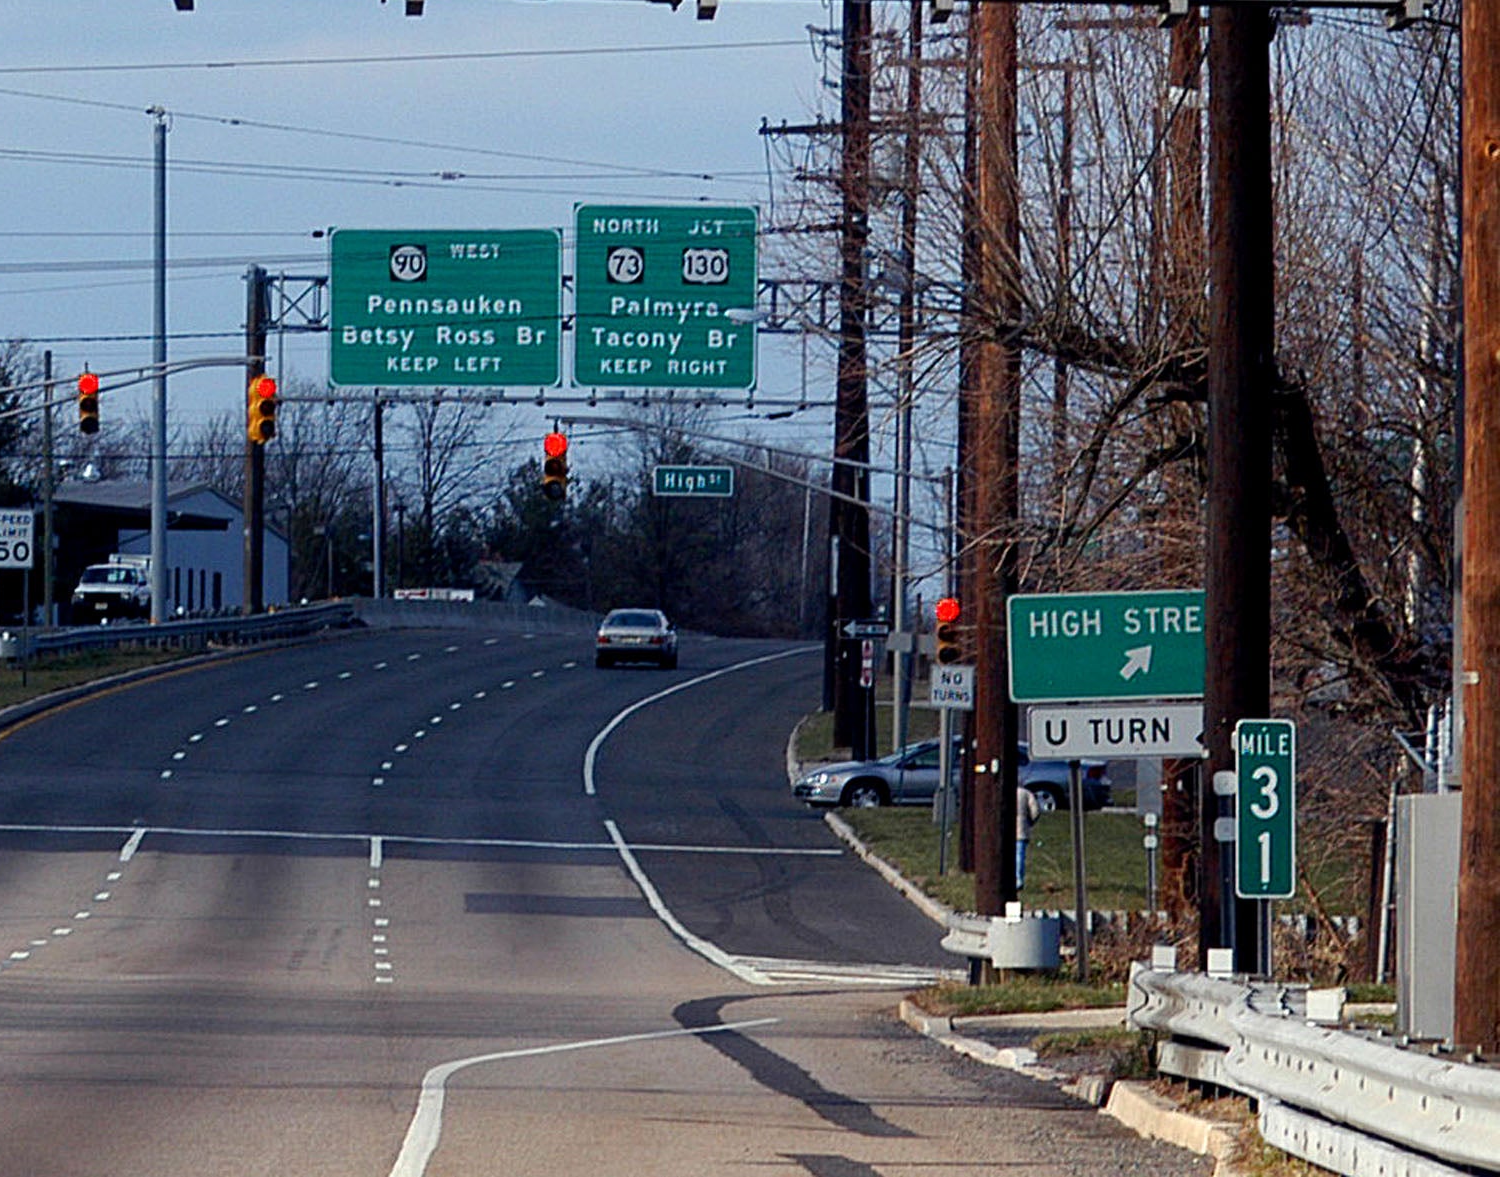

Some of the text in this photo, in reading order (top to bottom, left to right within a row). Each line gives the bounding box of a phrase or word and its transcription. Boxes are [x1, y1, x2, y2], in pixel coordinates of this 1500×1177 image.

[592, 218, 660, 235] NORTH
[450, 243, 501, 259] WEST
[394, 256, 422, 275] 90
[613, 256, 640, 275] 73
[685, 256, 725, 275] 130
[367, 294, 523, 315] Pennsauken
[610, 296, 720, 323] Palmyra
[342, 325, 547, 350] Betsy Ross Br
[591, 326, 738, 353] Tacony Br
[386, 356, 503, 373] KEEP LEFT
[600, 358, 728, 376] KEEP RIGHT
[664, 472, 706, 493] High
[1029, 609, 1102, 637] HIGH
[941, 672, 963, 686] NO
[933, 688, 970, 703] TURNS
[1044, 717, 1171, 746] U TURN
[1240, 732, 1290, 757] MILE
